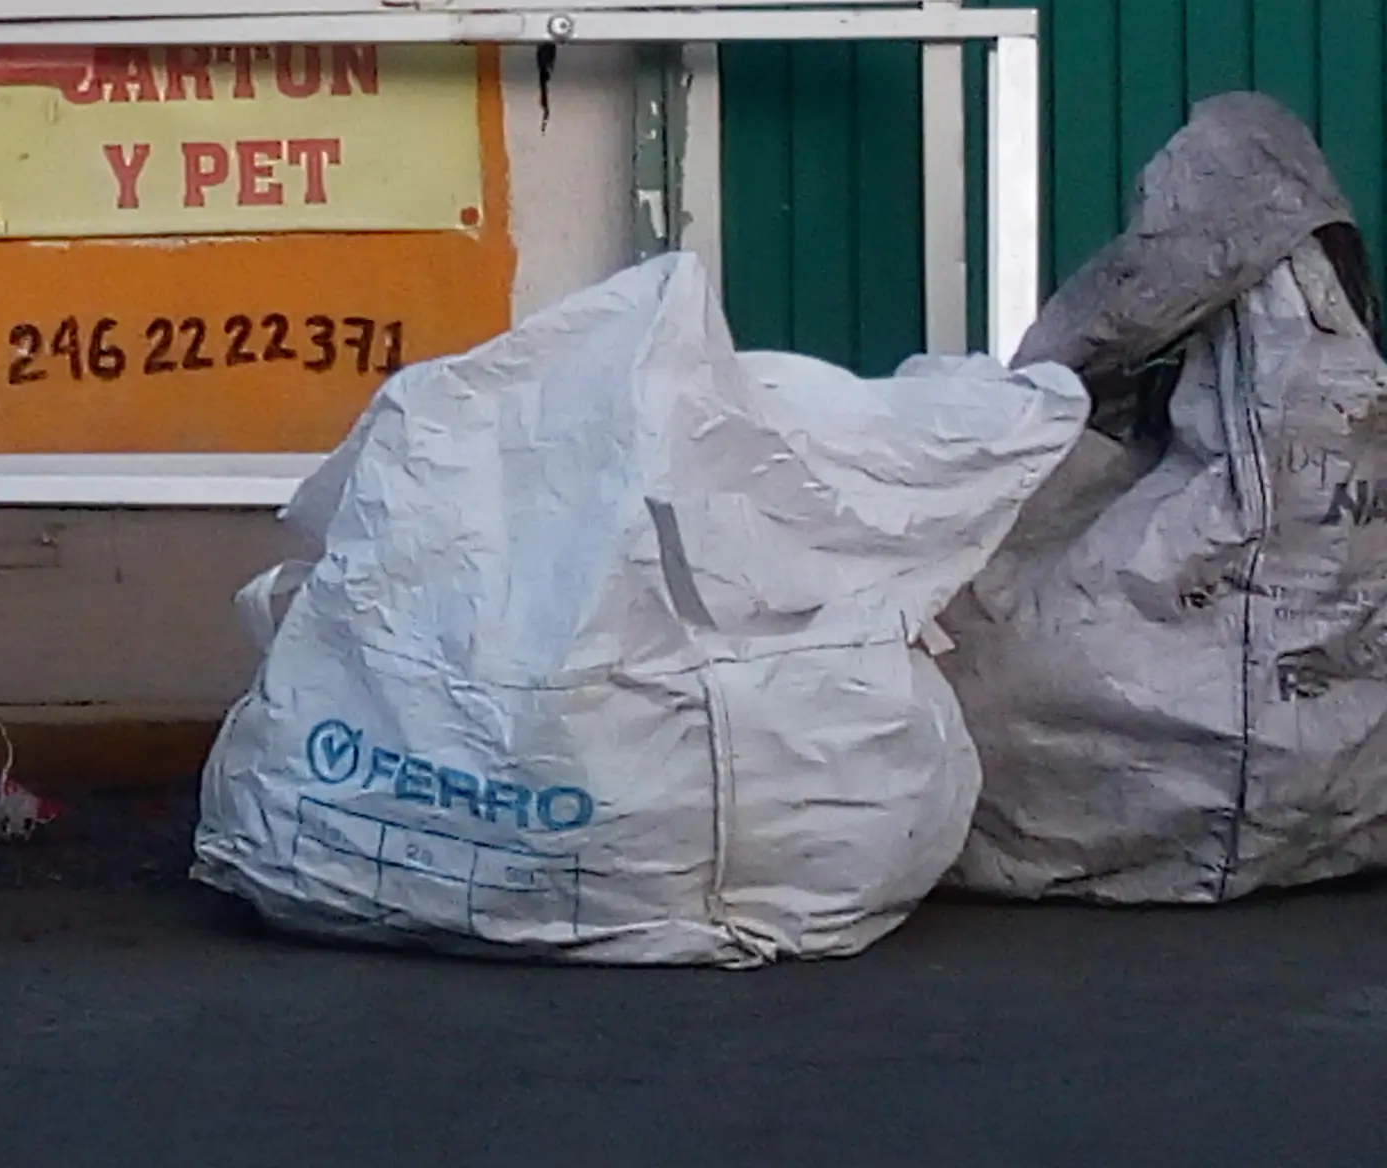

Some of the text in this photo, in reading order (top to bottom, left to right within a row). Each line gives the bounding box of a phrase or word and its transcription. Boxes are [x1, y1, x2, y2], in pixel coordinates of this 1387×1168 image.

[103, 137, 342, 209] Y PET
[362, 744, 595, 831] FERRO
